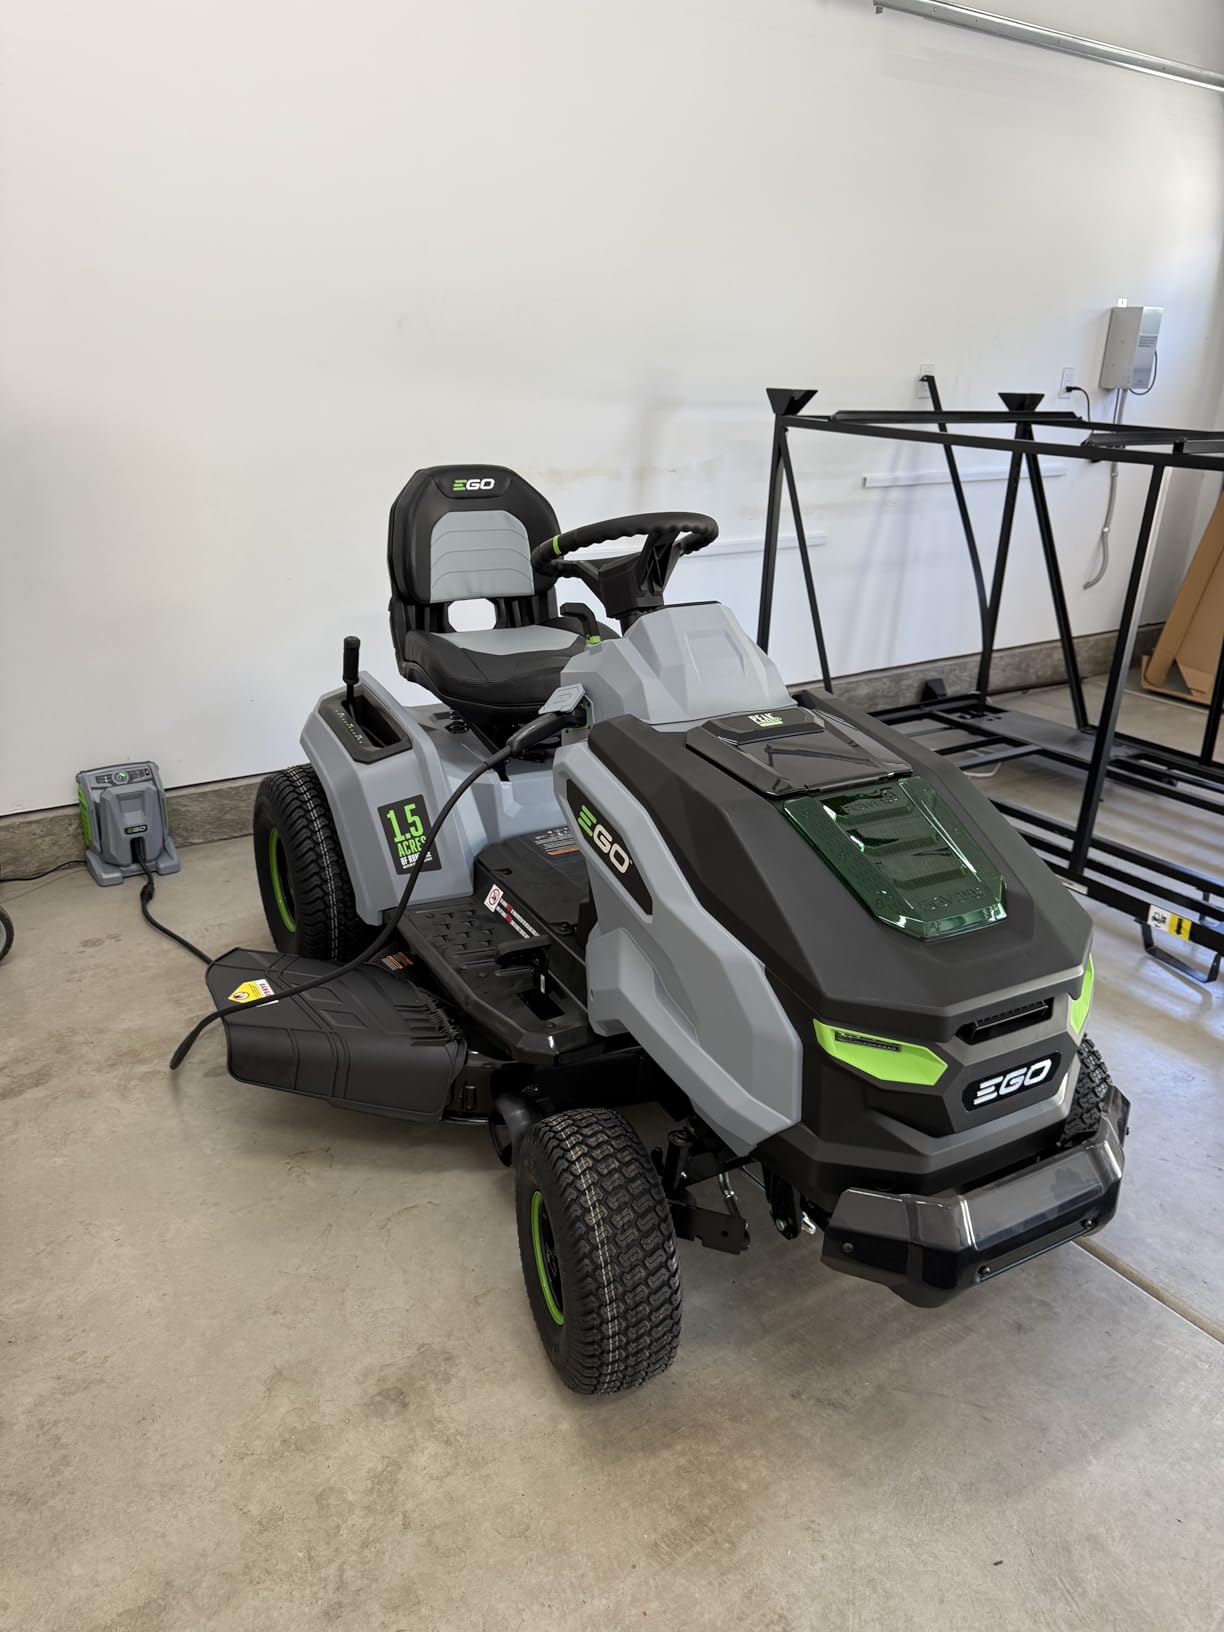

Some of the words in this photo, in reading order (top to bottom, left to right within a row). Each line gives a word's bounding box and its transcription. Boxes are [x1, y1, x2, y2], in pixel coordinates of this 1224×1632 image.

[453, 479, 495, 490] EGO
[387, 803, 424, 843] 1.5
[578, 805, 630, 873] EGO
[974, 1059, 1053, 1105] EGO
